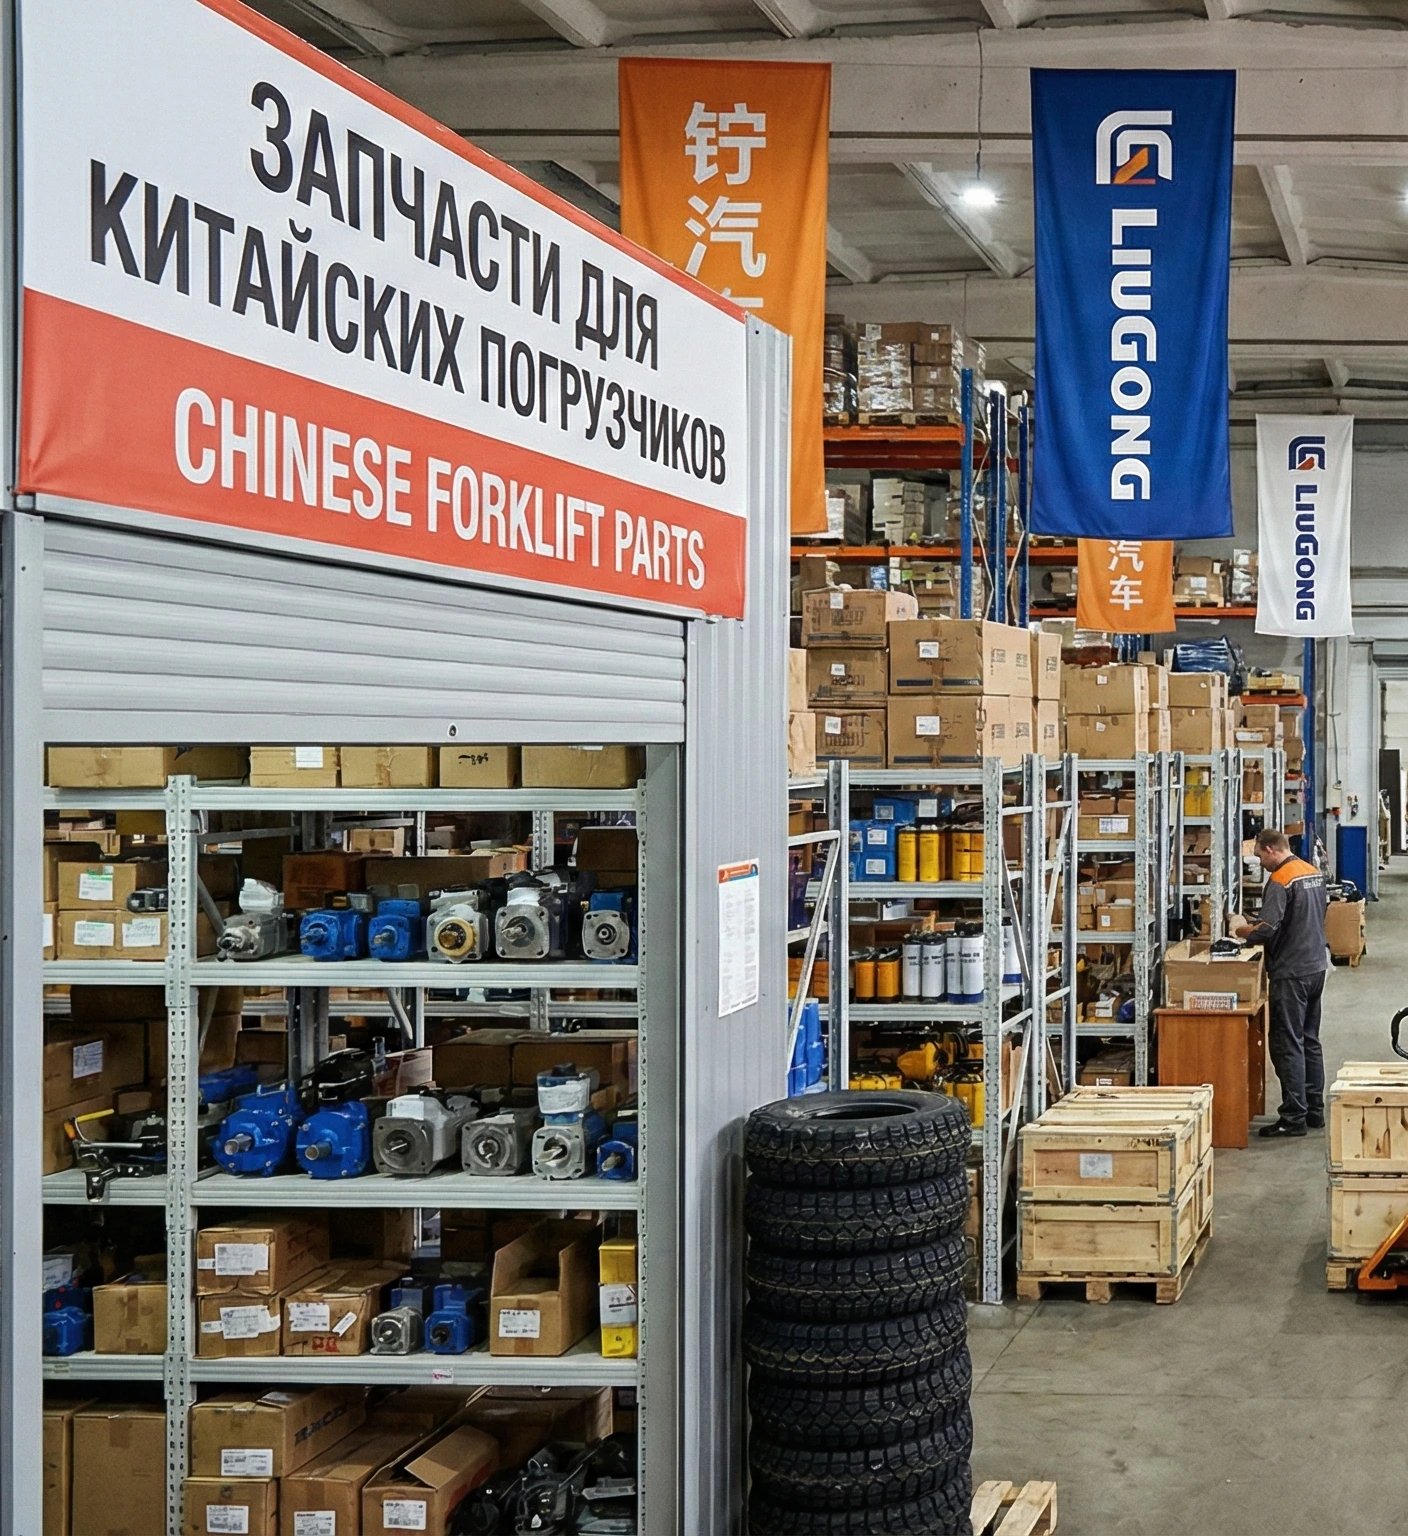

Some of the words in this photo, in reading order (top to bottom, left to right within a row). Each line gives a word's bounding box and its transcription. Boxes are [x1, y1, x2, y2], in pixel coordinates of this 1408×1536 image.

[90, 158, 465, 394] КИТАЙСКИХ
[480, 324, 727, 486] ПОГРУЗЧИКОВ
[250, 81, 561, 324] ЗАПЧАСТИ
[575, 260, 659, 370] ДЛЯ
[1110, 208, 1158, 500] LIUGONG
[174, 387, 413, 526] CHINESE
[426, 457, 604, 566] FORKLIFT
[614, 518, 706, 590] PARTS
[1107, 540, 1145, 611] 汽车
[1295, 484, 1319, 621] LIUGONG
